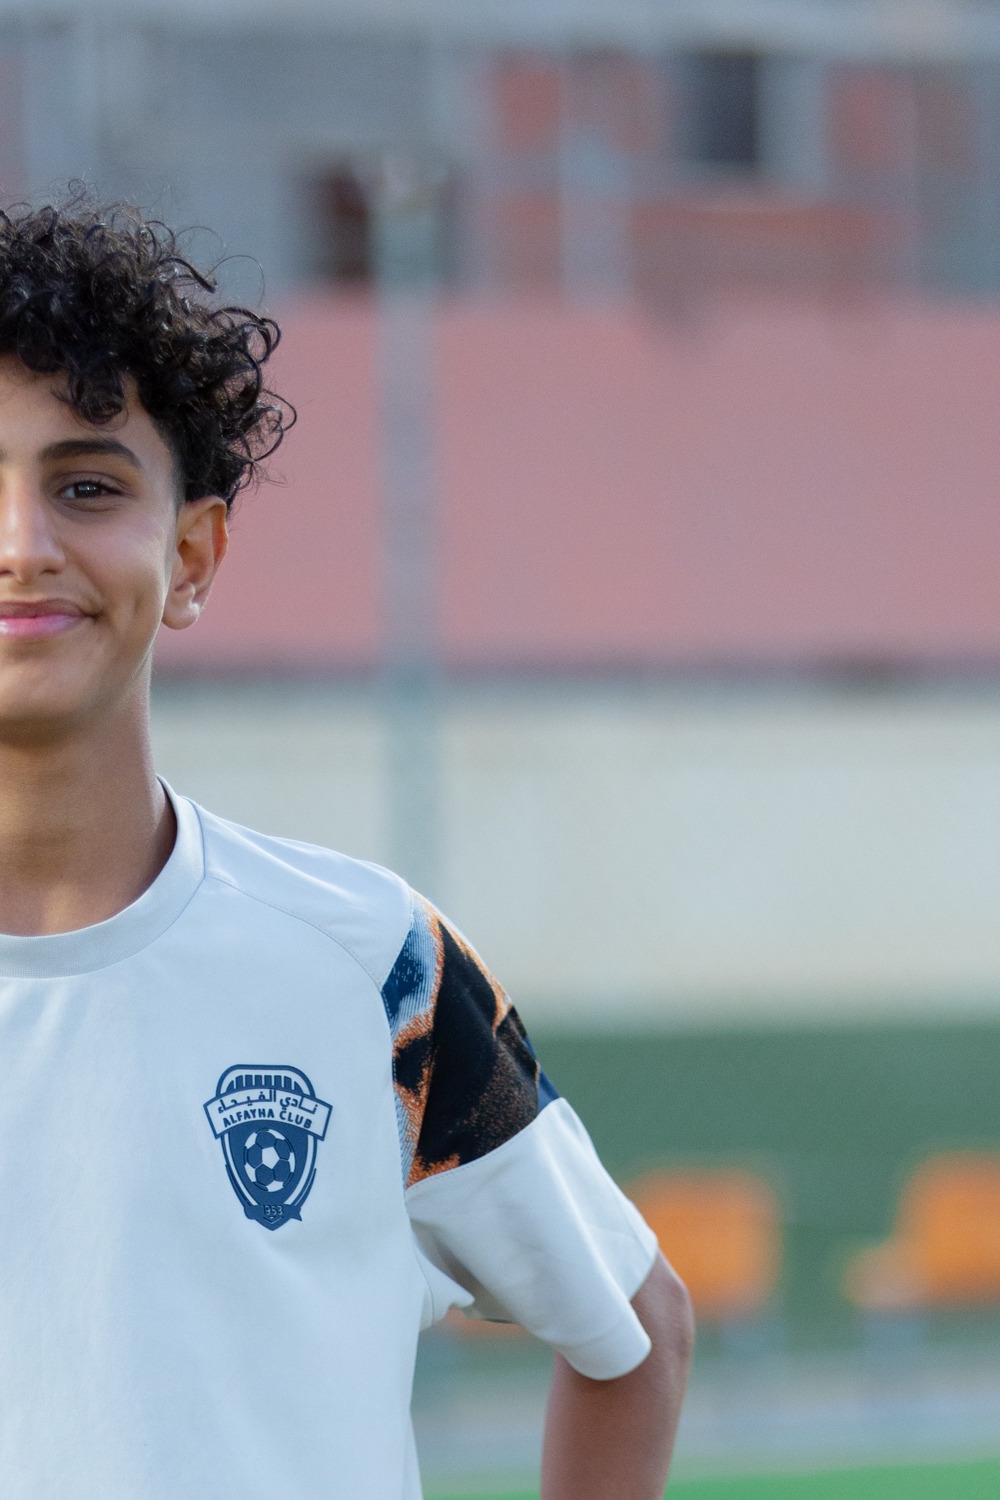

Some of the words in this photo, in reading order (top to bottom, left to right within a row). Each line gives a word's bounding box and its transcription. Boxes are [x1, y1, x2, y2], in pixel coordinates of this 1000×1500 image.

[217, 1088, 277, 1114] الفيحاء
[280, 1095, 319, 1115] نادي
[222, 1107, 275, 1128] ALFAYHA
[279, 1110, 313, 1129] CLUB
